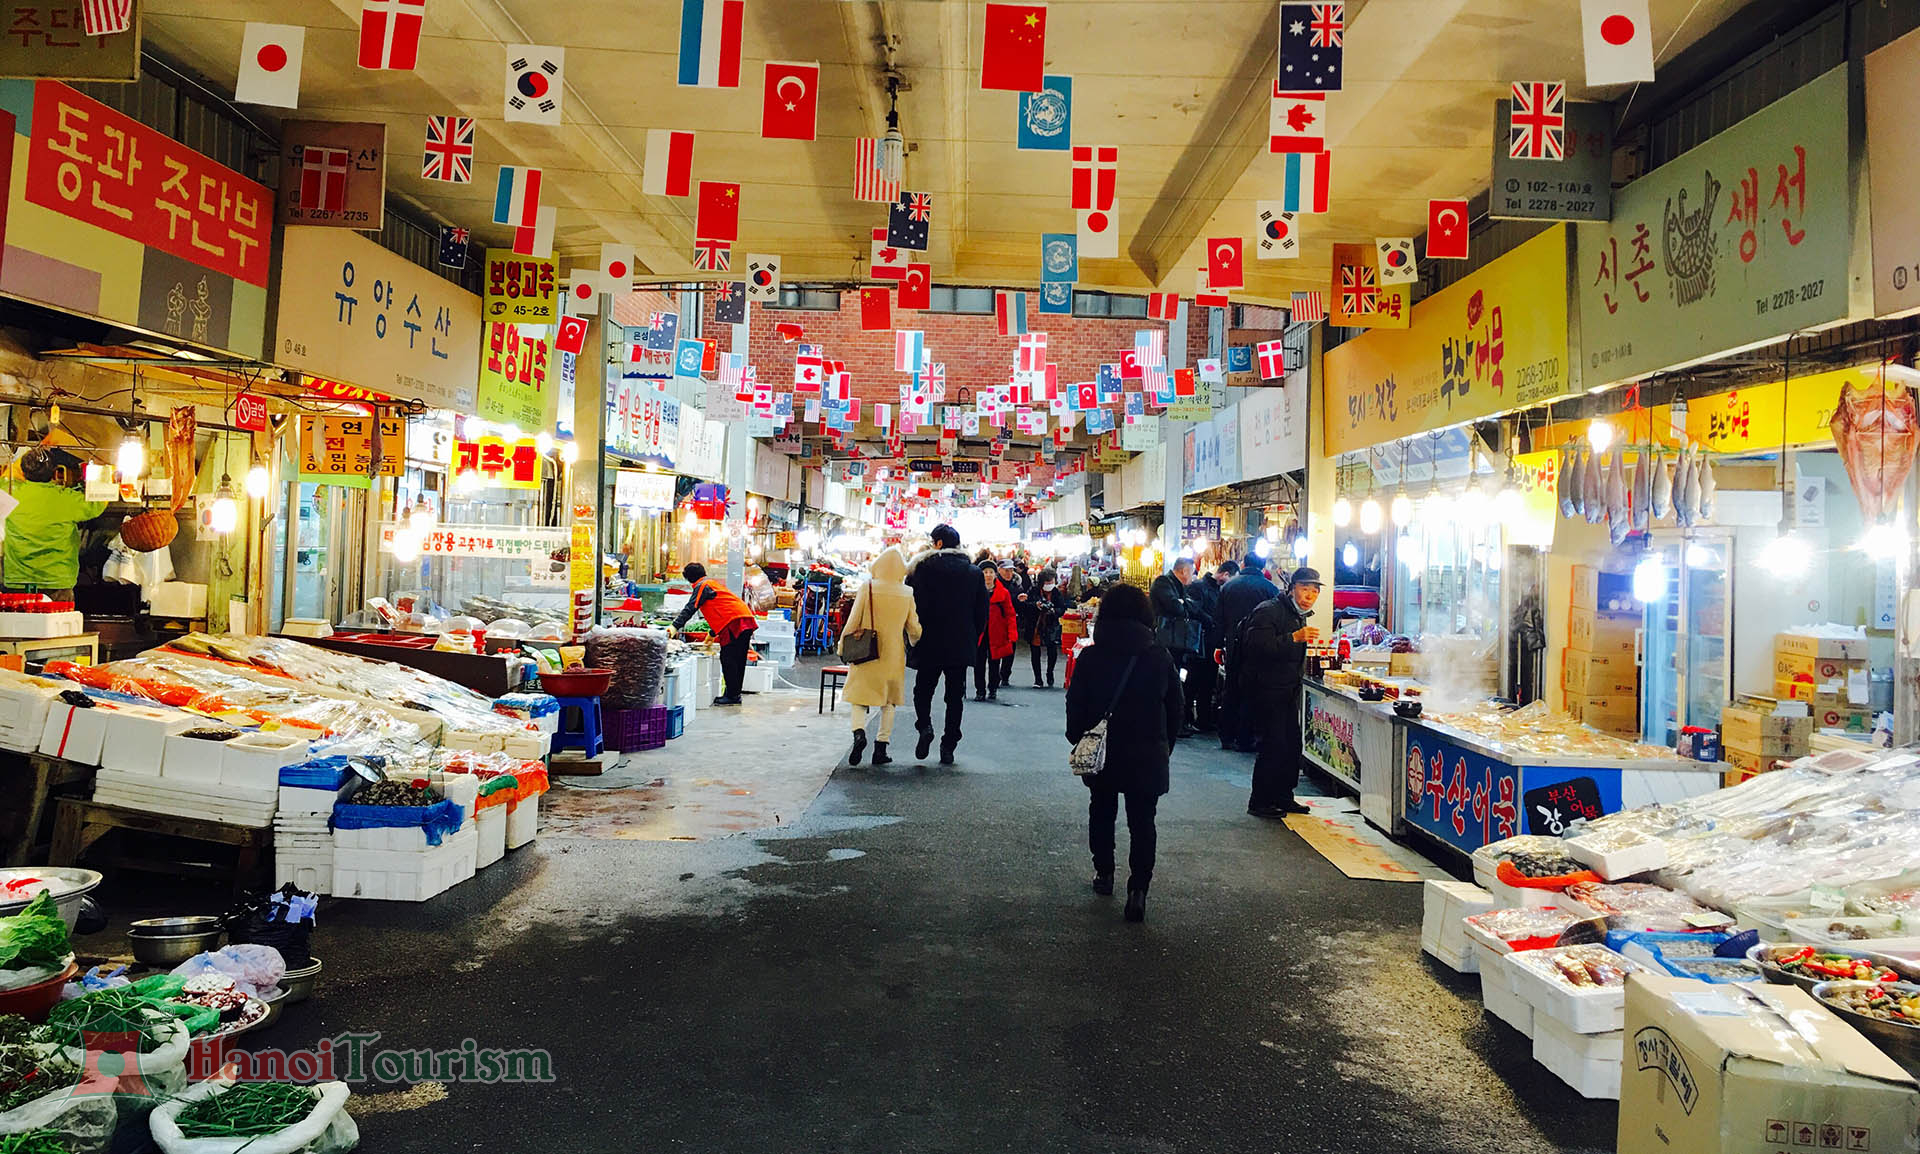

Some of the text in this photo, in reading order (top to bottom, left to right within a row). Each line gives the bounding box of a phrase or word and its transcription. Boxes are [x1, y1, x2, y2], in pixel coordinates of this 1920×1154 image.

[48, 101, 260, 268] 동관 주단부
[289, 208, 369, 221] Tel 2267-2735
[1505, 198, 1595, 212] Tel 2278-2027
[1594, 144, 1806, 314] 신촌 생선
[489, 260, 554, 299] 보영고추
[1756, 279, 1825, 315] Tel 2278-2027
[335, 261, 451, 360] 유양수산
[514, 306, 551, 316] 45-2호
[487, 320, 547, 392] 보영고추
[250, 401, 265, 419] 금연
[1425, 749, 1517, 846] 부산어묵
[1547, 785, 1578, 802] 부산
